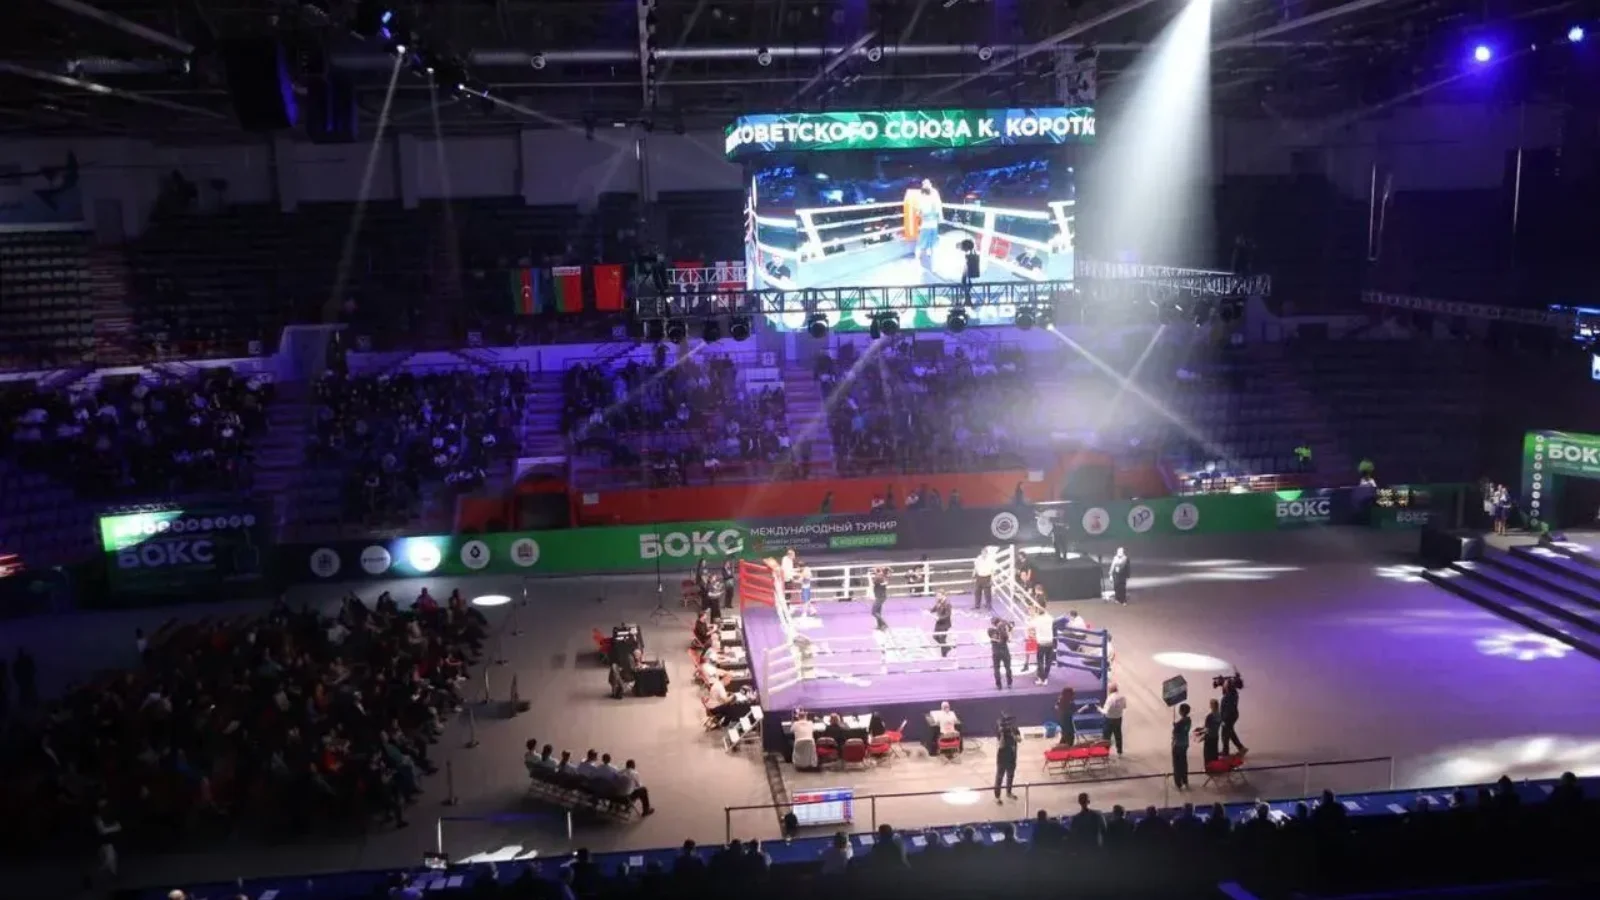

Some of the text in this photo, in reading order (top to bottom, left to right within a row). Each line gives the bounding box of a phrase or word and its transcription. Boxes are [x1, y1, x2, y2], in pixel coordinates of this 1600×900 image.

[885, 118, 972, 139] СОЮЗА
[978, 117, 1000, 136] К.
[1548, 443, 1600, 464] БОК
[1276, 500, 1330, 518] БОКС
[750, 520, 897, 536] МЕЖДУНАРОДНЫЙ ТУРНИР
[639, 529, 744, 559] БОКС
